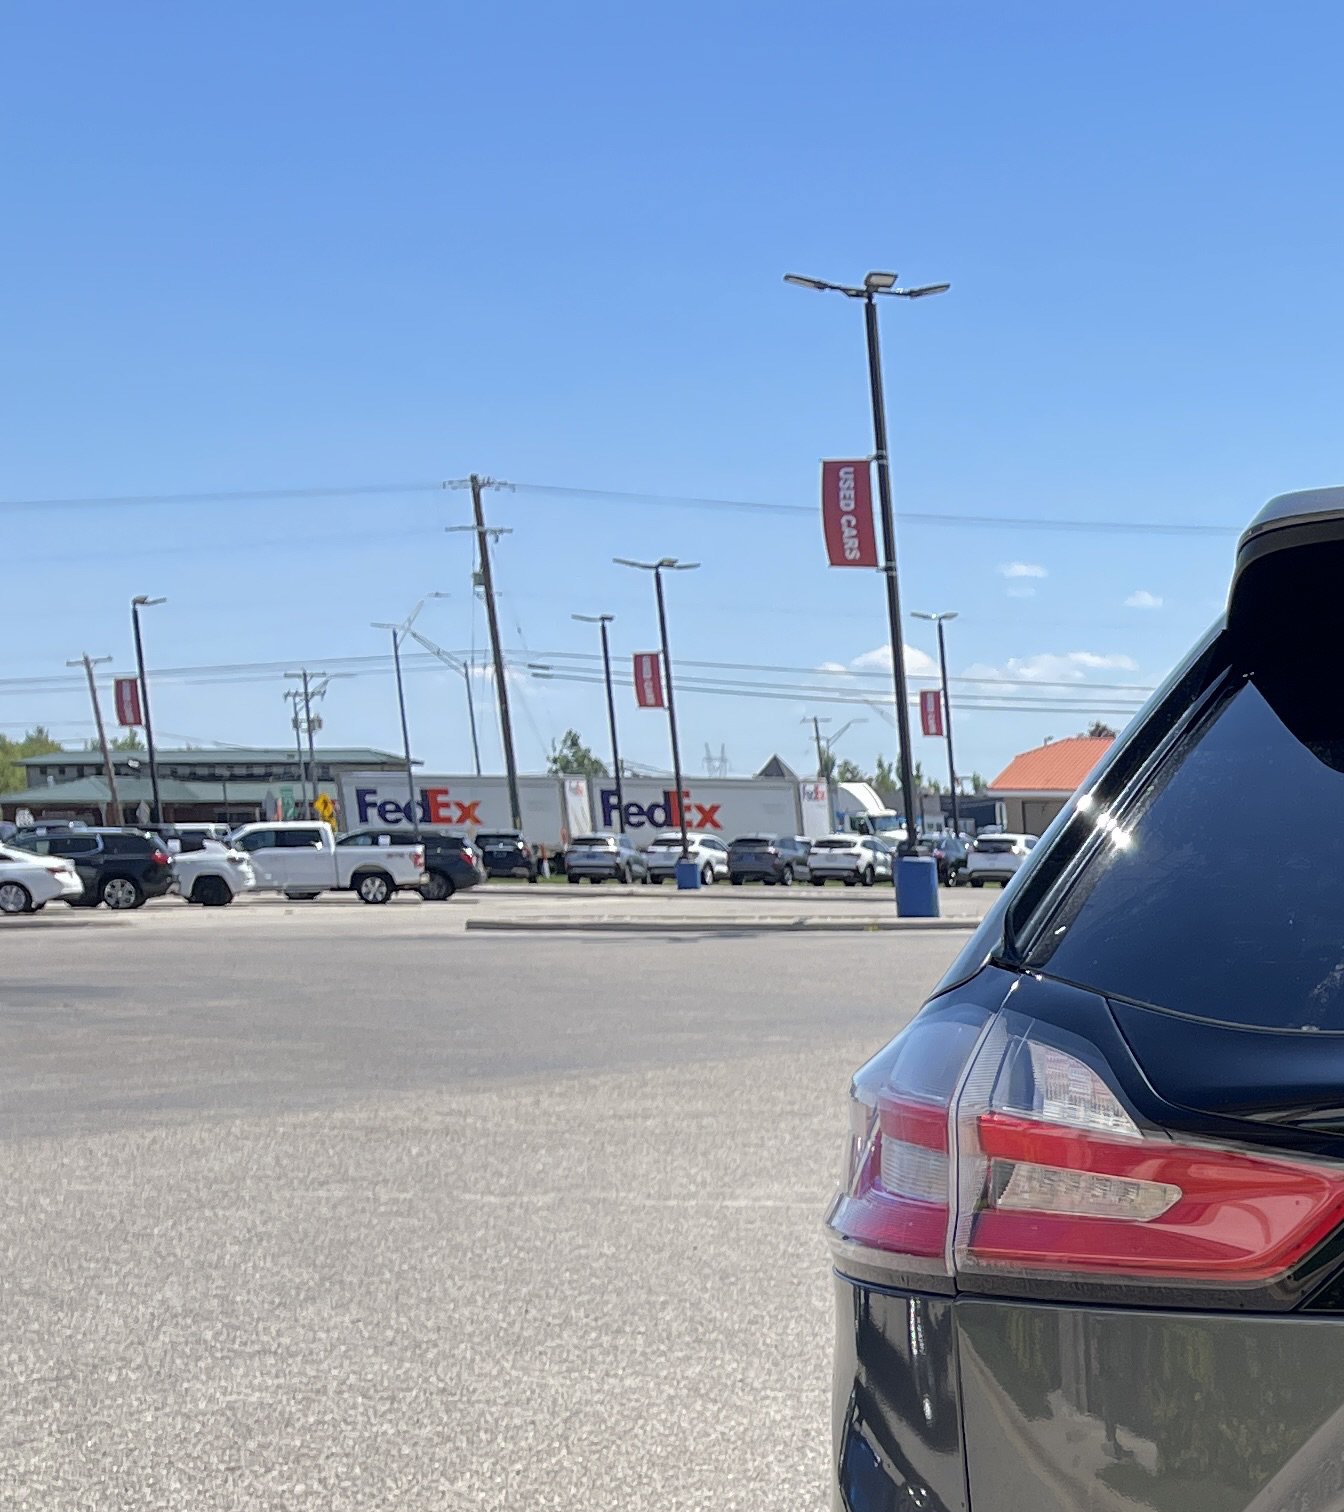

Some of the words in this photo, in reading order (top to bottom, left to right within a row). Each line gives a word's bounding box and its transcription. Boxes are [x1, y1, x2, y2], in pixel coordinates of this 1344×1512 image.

[839, 466, 856, 512] USED
[840, 514, 861, 561] CARS
[355, 787, 482, 825] FedEx
[600, 789, 723, 830] FedEx
